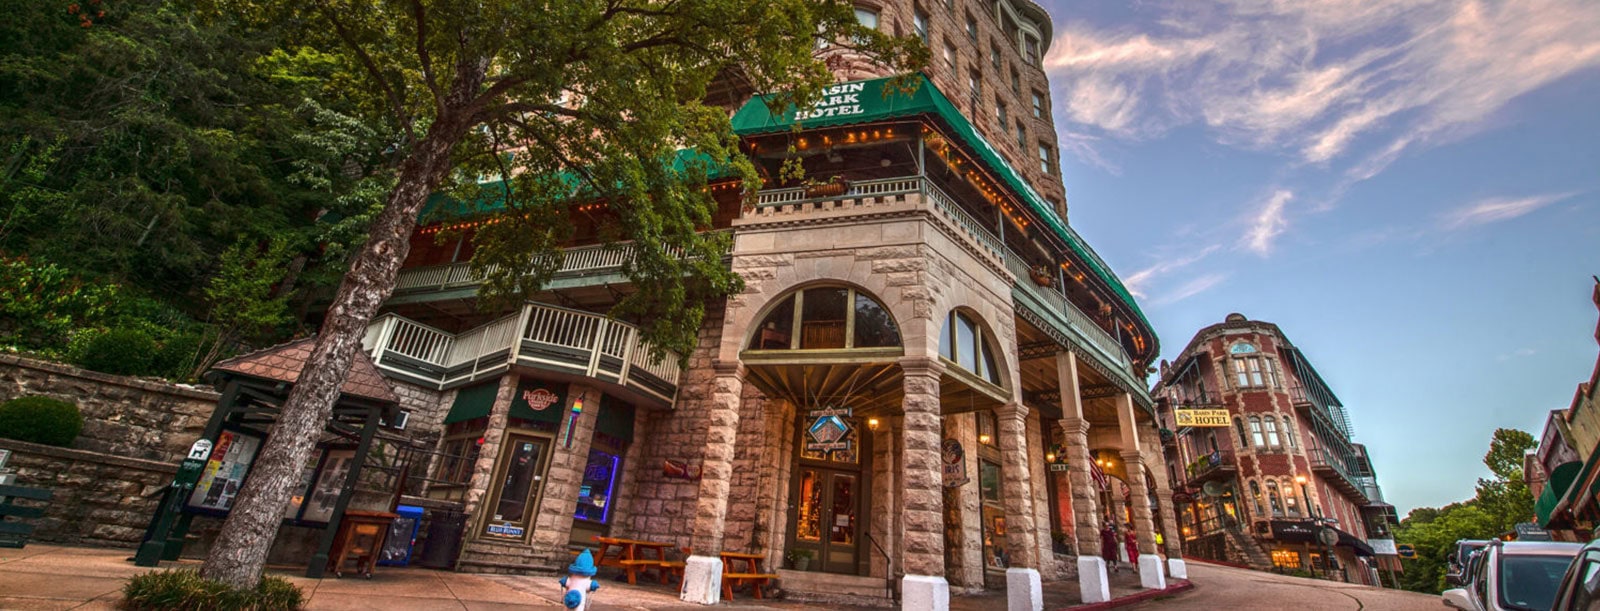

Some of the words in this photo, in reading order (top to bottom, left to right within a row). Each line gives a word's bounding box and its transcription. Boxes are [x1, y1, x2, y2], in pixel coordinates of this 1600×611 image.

[814, 82, 865, 97] ASIN
[795, 105, 864, 120] HOTEL
[523, 390, 559, 403] Parkside
[1195, 416, 1230, 424] HOTEL
